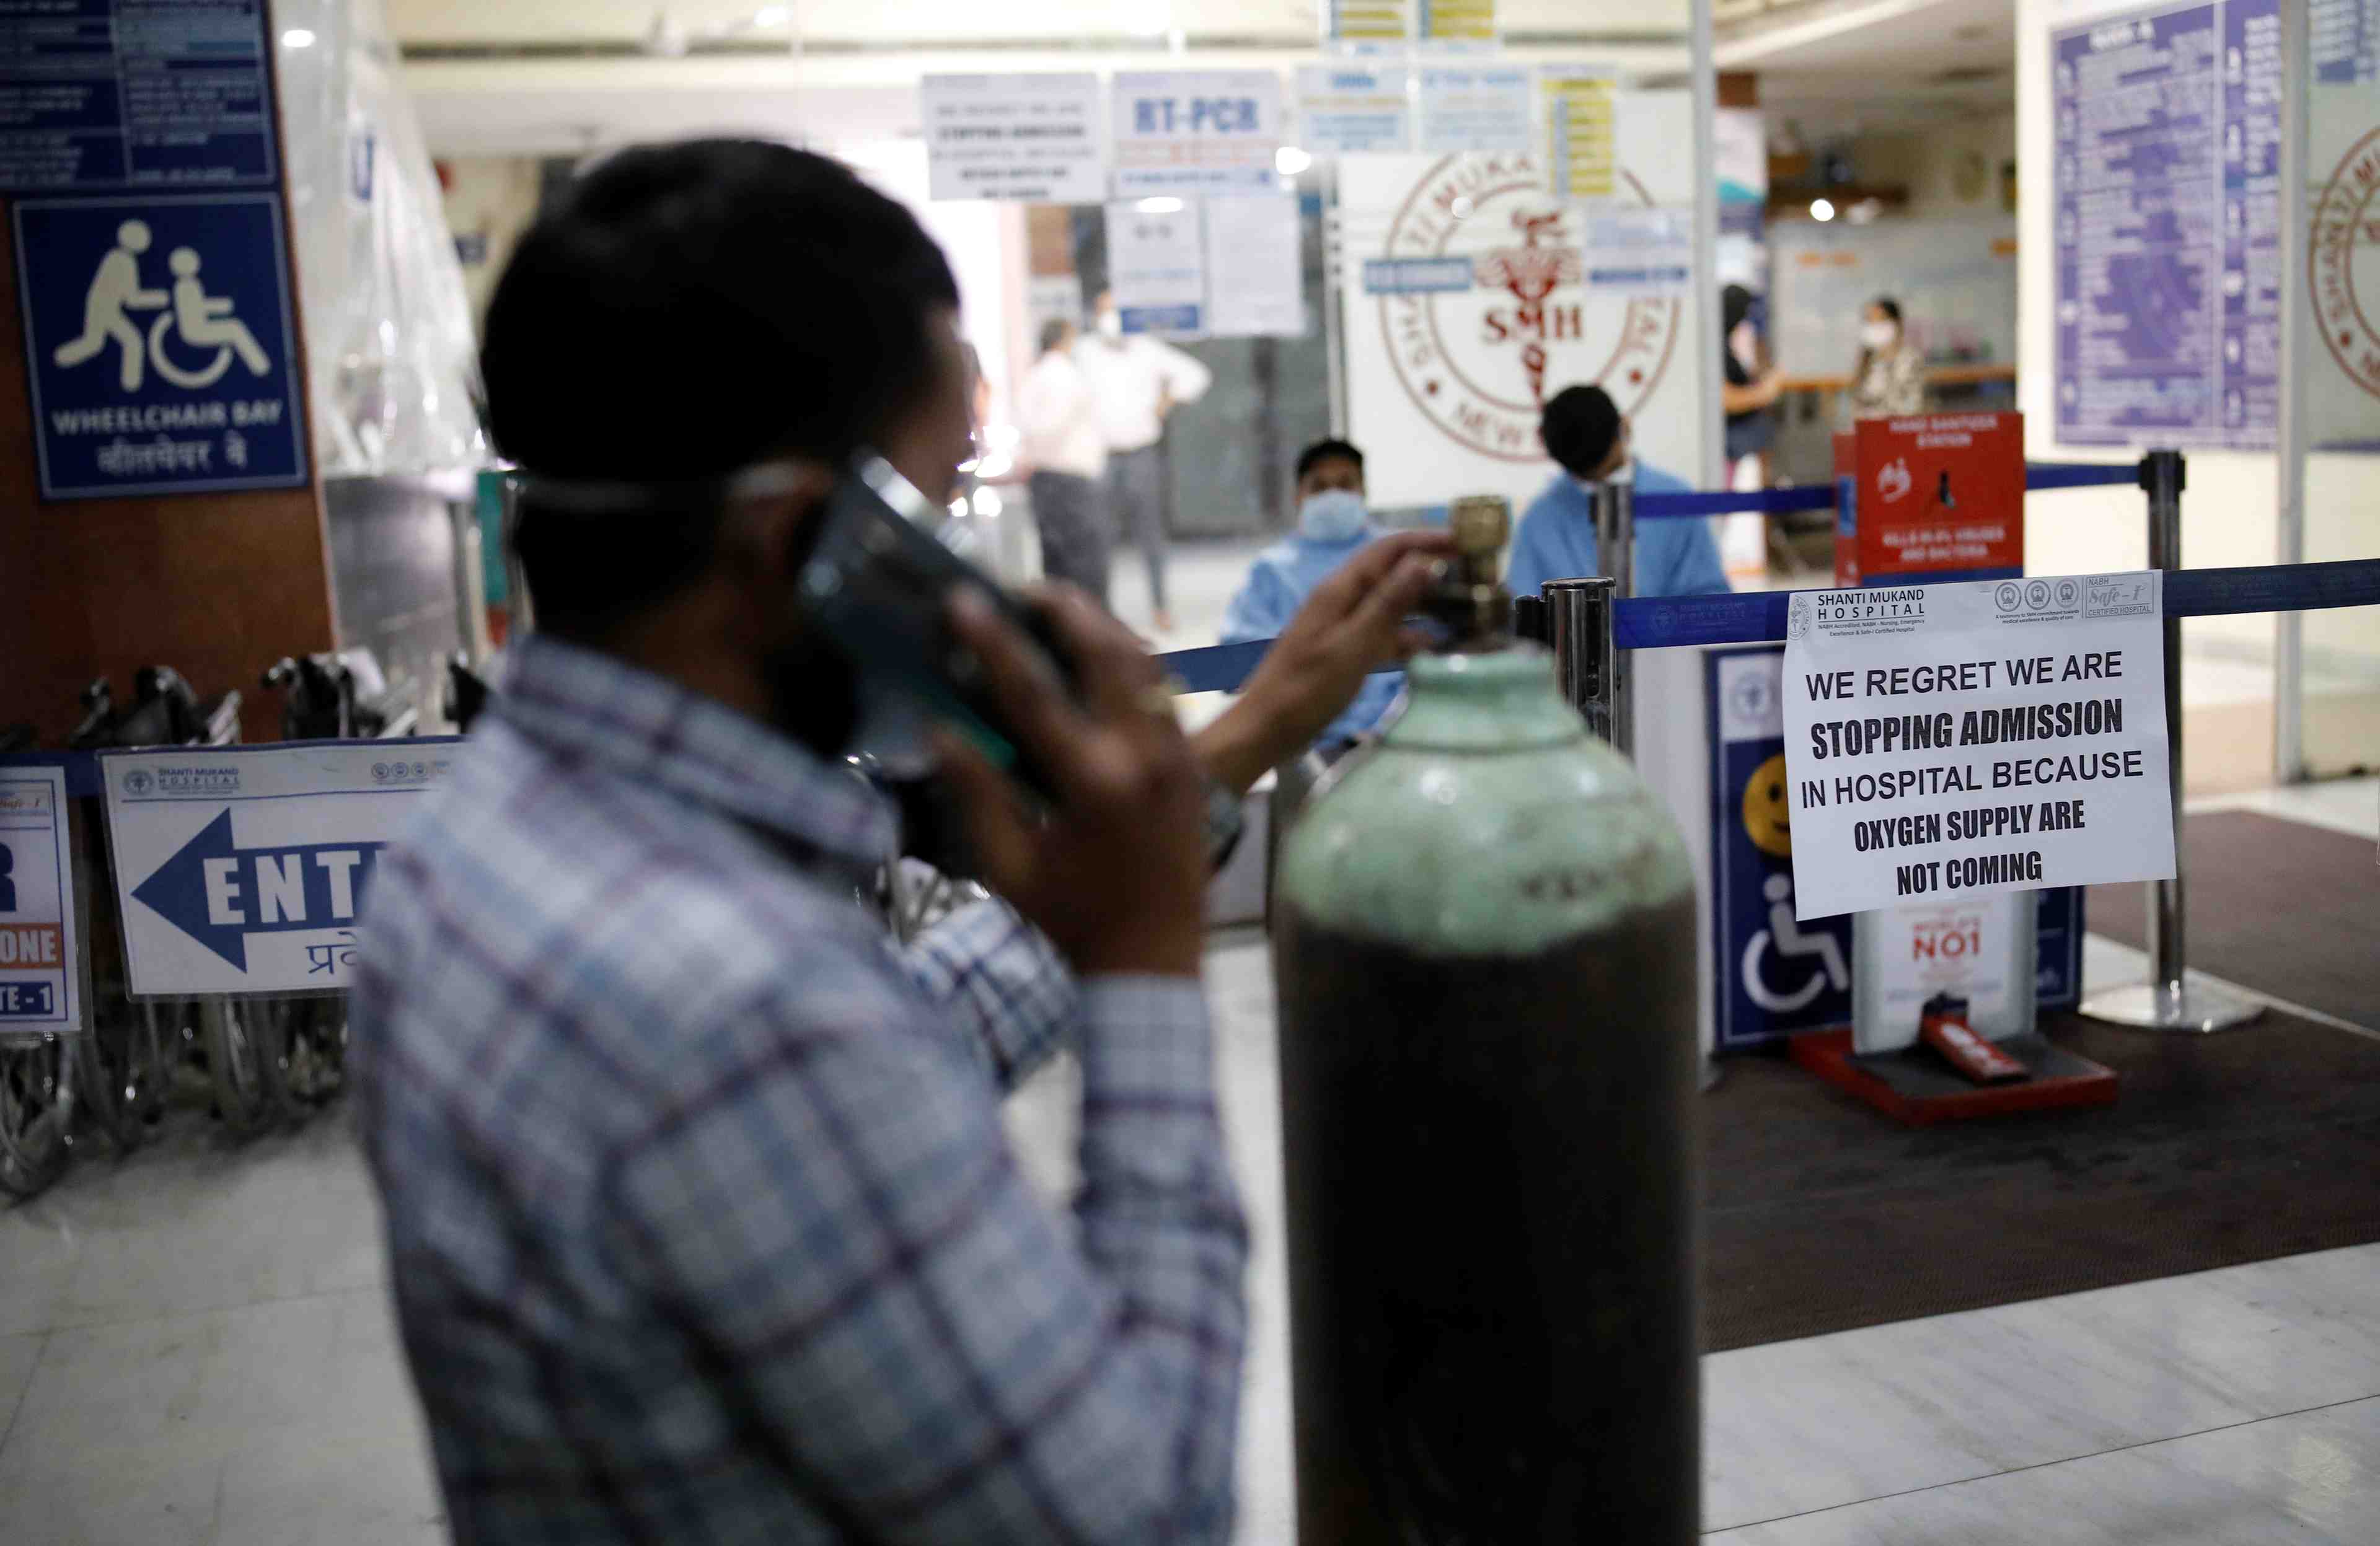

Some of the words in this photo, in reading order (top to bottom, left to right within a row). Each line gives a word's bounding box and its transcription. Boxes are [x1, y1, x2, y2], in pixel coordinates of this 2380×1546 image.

[52, 400, 227, 435] WHEELCHAIR
[231, 397, 283, 426] BAY
[1818, 593, 1865, 606] SHANTI
[1869, 589, 1924, 604] MUKAND
[2087, 578, 2109, 586] NABH
[1818, 602, 1924, 620] HOSPITAL
[2087, 607, 2119, 617] CERTIFIED
[2120, 605, 2151, 614] HOSPITAL
[1806, 672, 1854, 701] WE
[1867, 661, 1996, 696] REGRET
[2006, 657, 2053, 686] WE
[2061, 651, 2122, 682] ARE
[1811, 713, 1952, 759] STOPPING
[1960, 698, 2122, 745] ADMISSION
[1802, 780, 1825, 808] IN
[1835, 765, 1982, 804] HOSPITAL
[1993, 750, 2143, 788] BECAUSE
[1854, 813, 1941, 851] OXYGEN
[1947, 804, 2033, 840] SUPPLY
[2039, 800, 2085, 831] ARE
[203, 850, 386, 925] ENT
[1897, 862, 1940, 895] NOT
[1946, 851, 2042, 889] COMING
